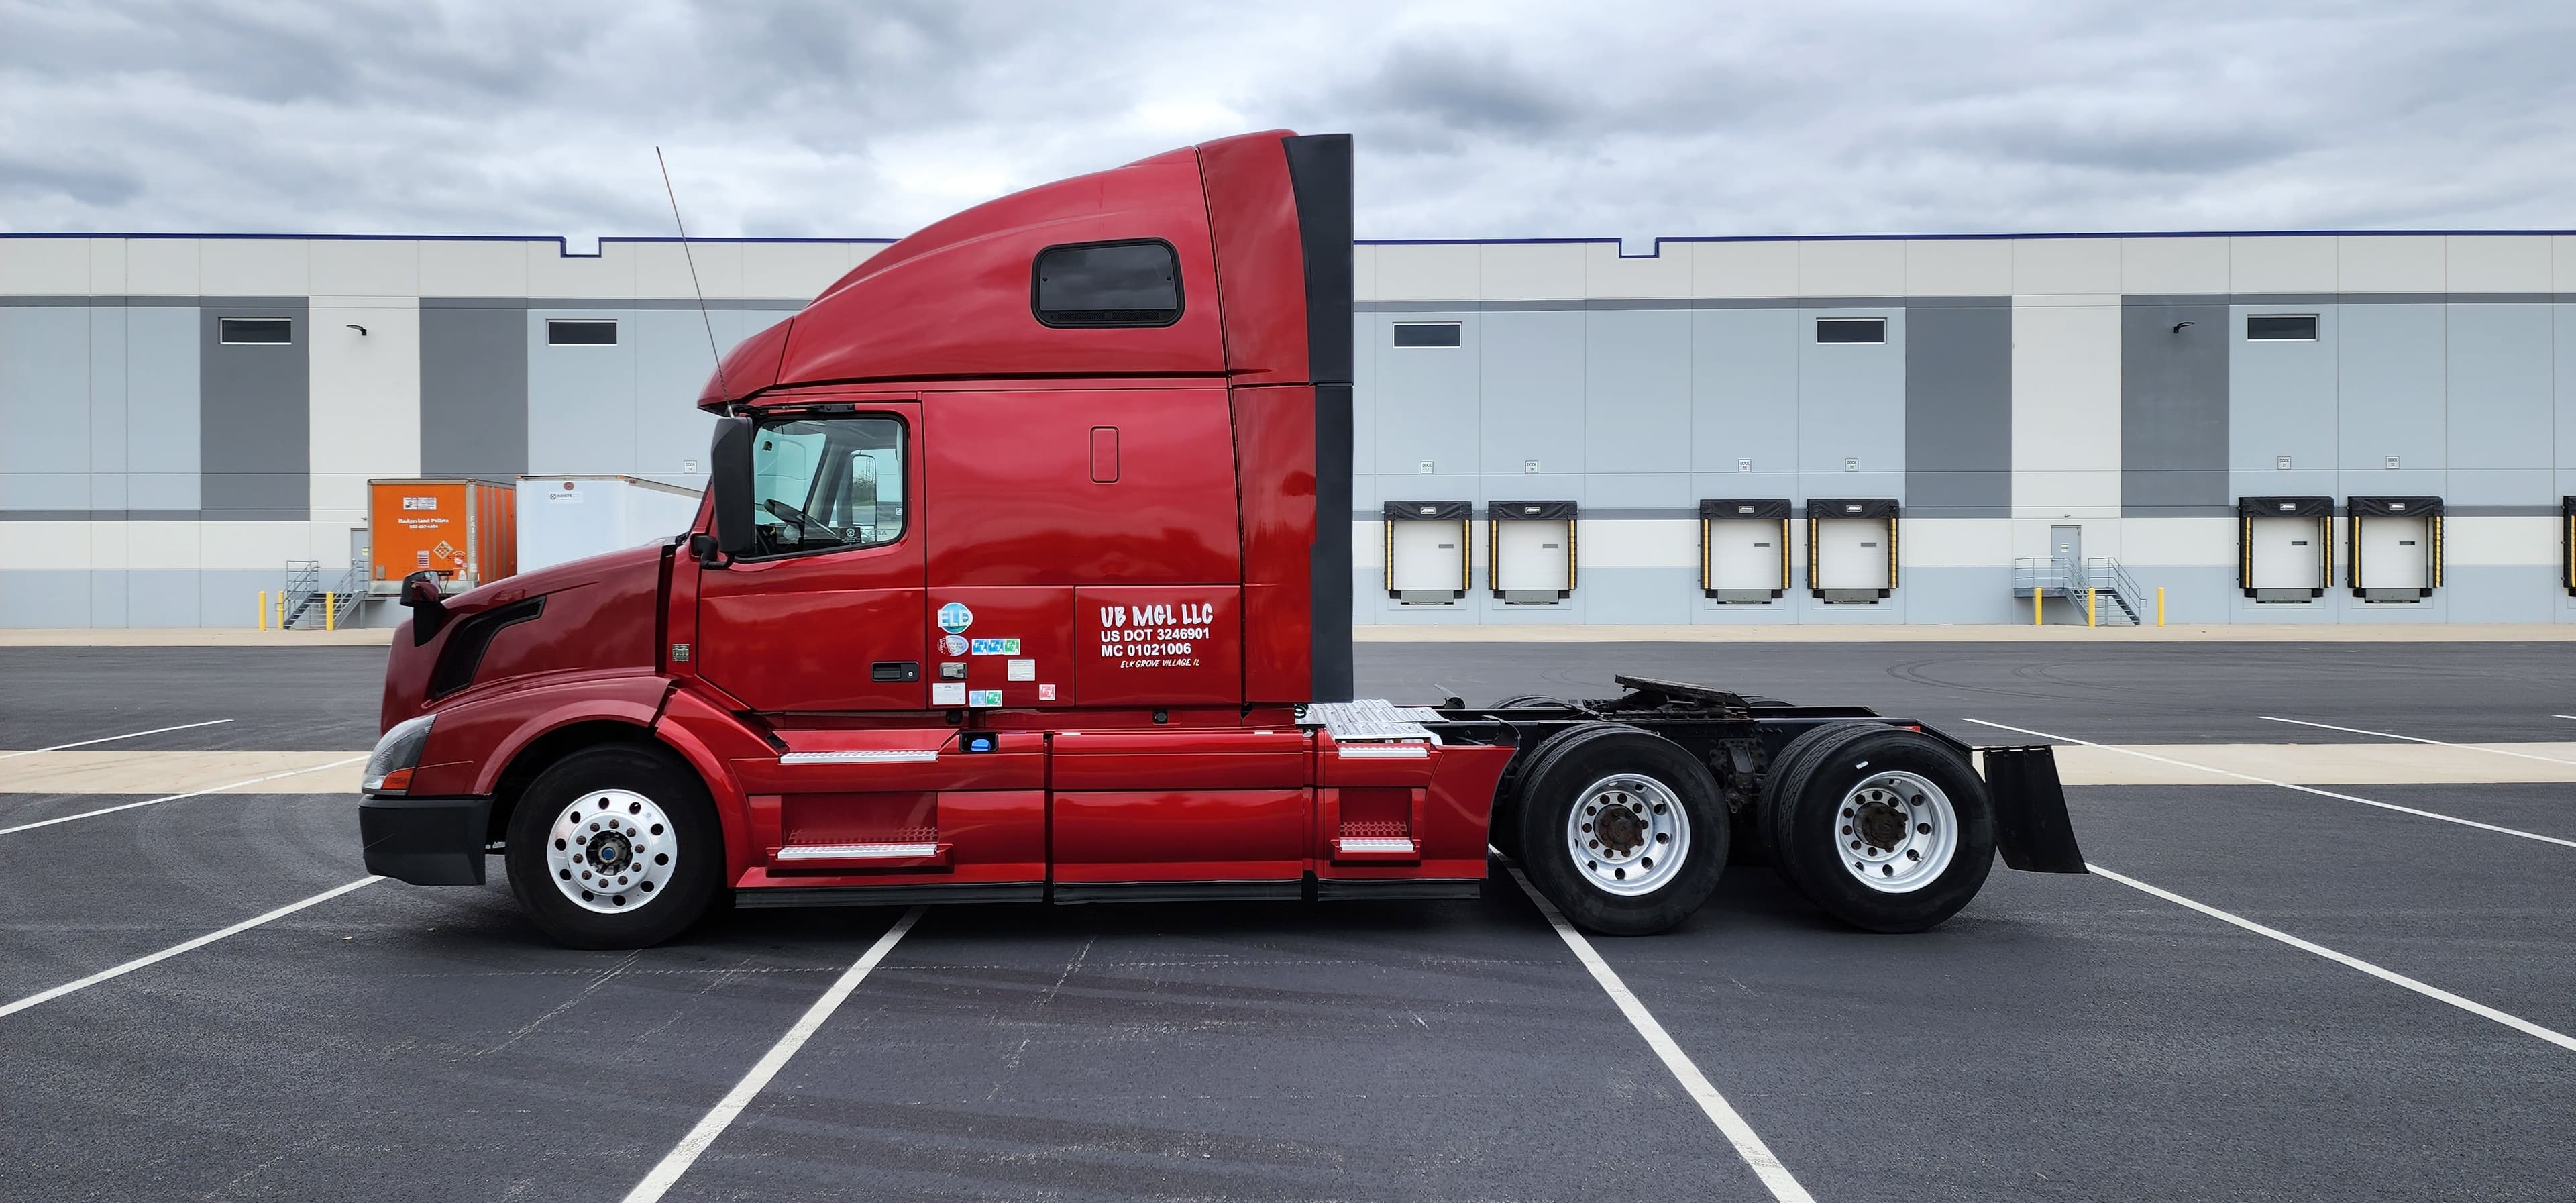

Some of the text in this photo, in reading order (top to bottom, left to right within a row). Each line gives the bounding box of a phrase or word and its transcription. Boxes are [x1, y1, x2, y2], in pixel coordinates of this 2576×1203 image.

[938, 609, 971, 627] ELD
[1100, 603, 1213, 628] UB MGL LLC
[1101, 627, 1210, 642] US DOT 3246901
[1102, 643, 1191, 657] MC 01021006
[1120, 660, 1135, 668] ELK
[1135, 659, 1161, 668] GROVE
[1193, 658, 1200, 666] IL
